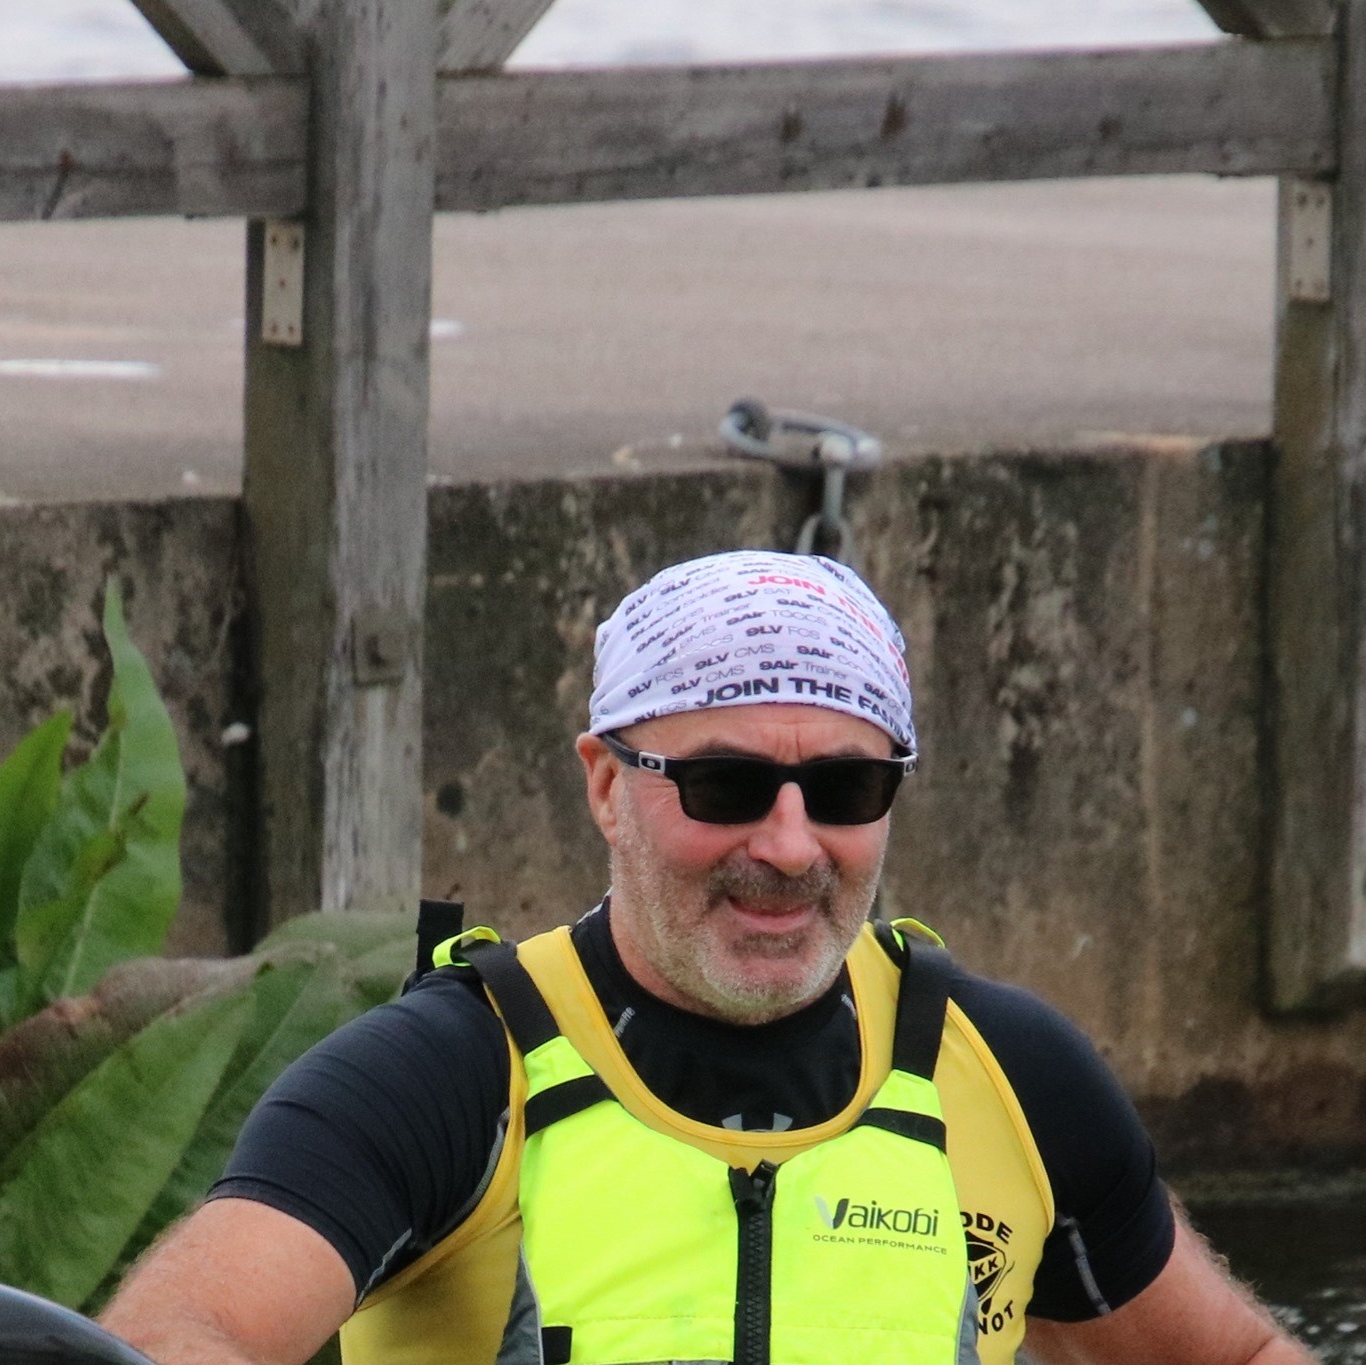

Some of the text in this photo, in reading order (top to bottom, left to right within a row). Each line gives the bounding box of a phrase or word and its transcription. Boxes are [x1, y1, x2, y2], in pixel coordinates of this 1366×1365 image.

[723, 588, 759, 602] 9LV
[748, 575, 826, 596] JOIN
[726, 610, 766, 626] 9Air
[745, 624, 784, 638] 9LV
[694, 652, 730, 671] 9LV
[734, 643, 775, 659] CMS
[796, 645, 835, 660] 9Air
[670, 664, 746, 696] 9LV CMS
[759, 659, 849, 681] 9Air Trainer
[627, 679, 653, 699] 9LV
[694, 677, 780, 708] JOIN
[787, 677, 853, 705] THE
[814, 1194, 940, 1237] Vaikobi
[812, 1233, 948, 1256] OCEAN PERFORMANCE
